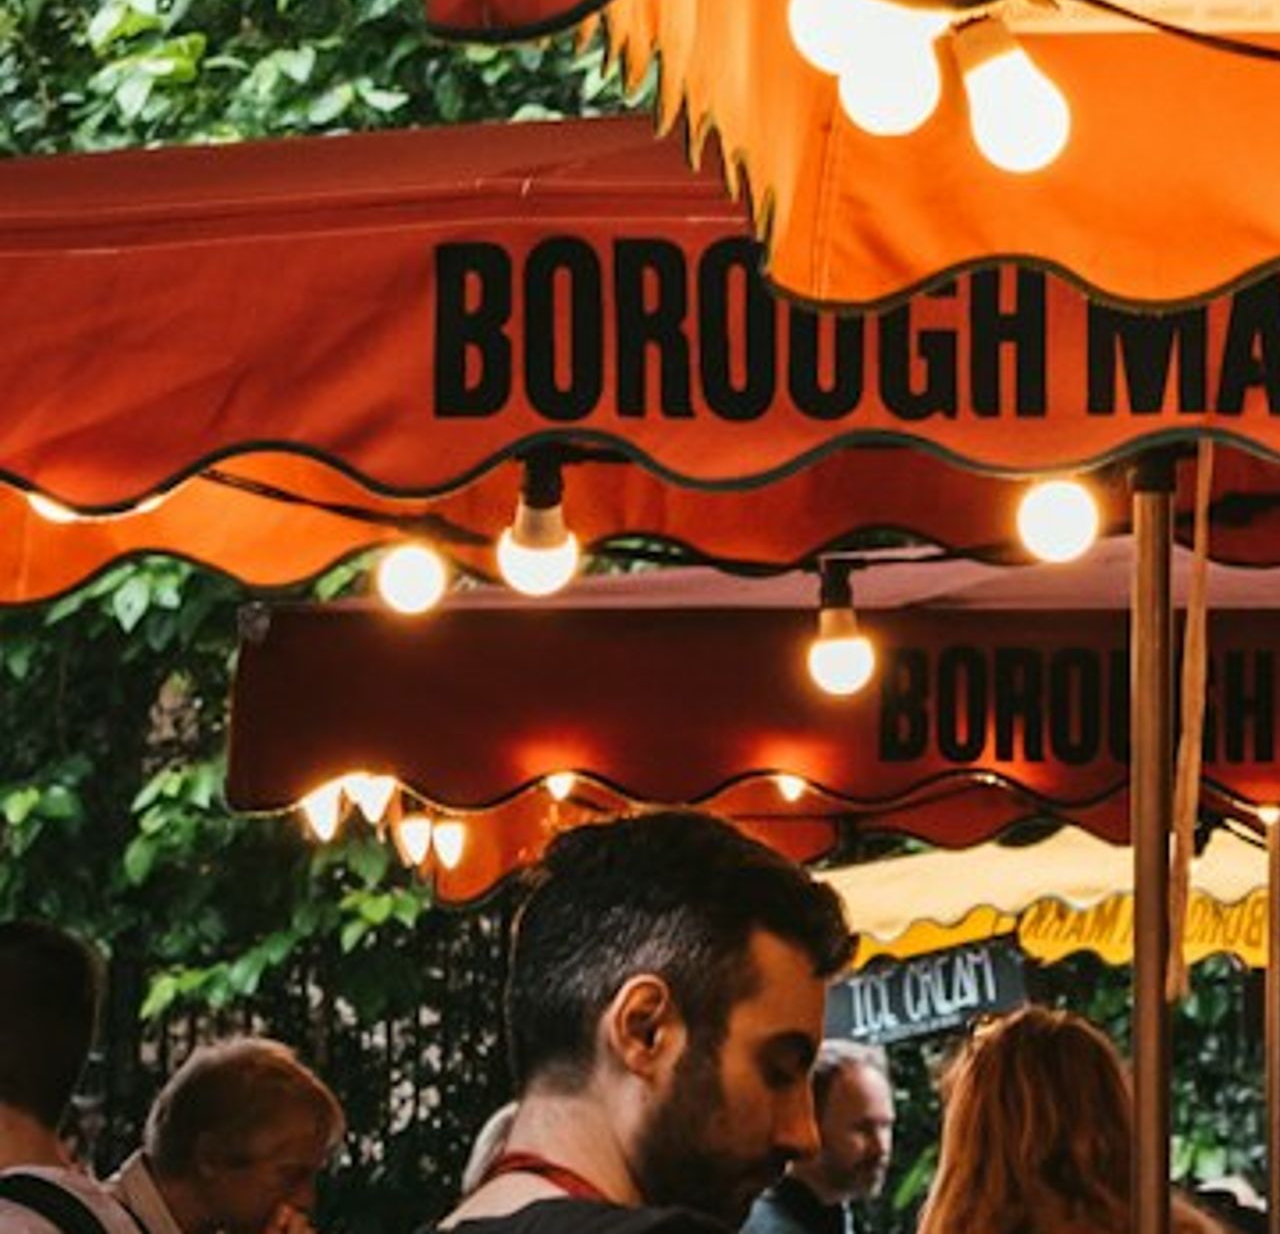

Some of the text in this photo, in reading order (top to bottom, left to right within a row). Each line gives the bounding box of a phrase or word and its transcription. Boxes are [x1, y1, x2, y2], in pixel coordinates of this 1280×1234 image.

[433, 234, 1048, 422] BOROUGH
[879, 646, 1274, 766] BOROH
[848, 969, 899, 1037] ICE
[904, 948, 997, 1023] CREAM
